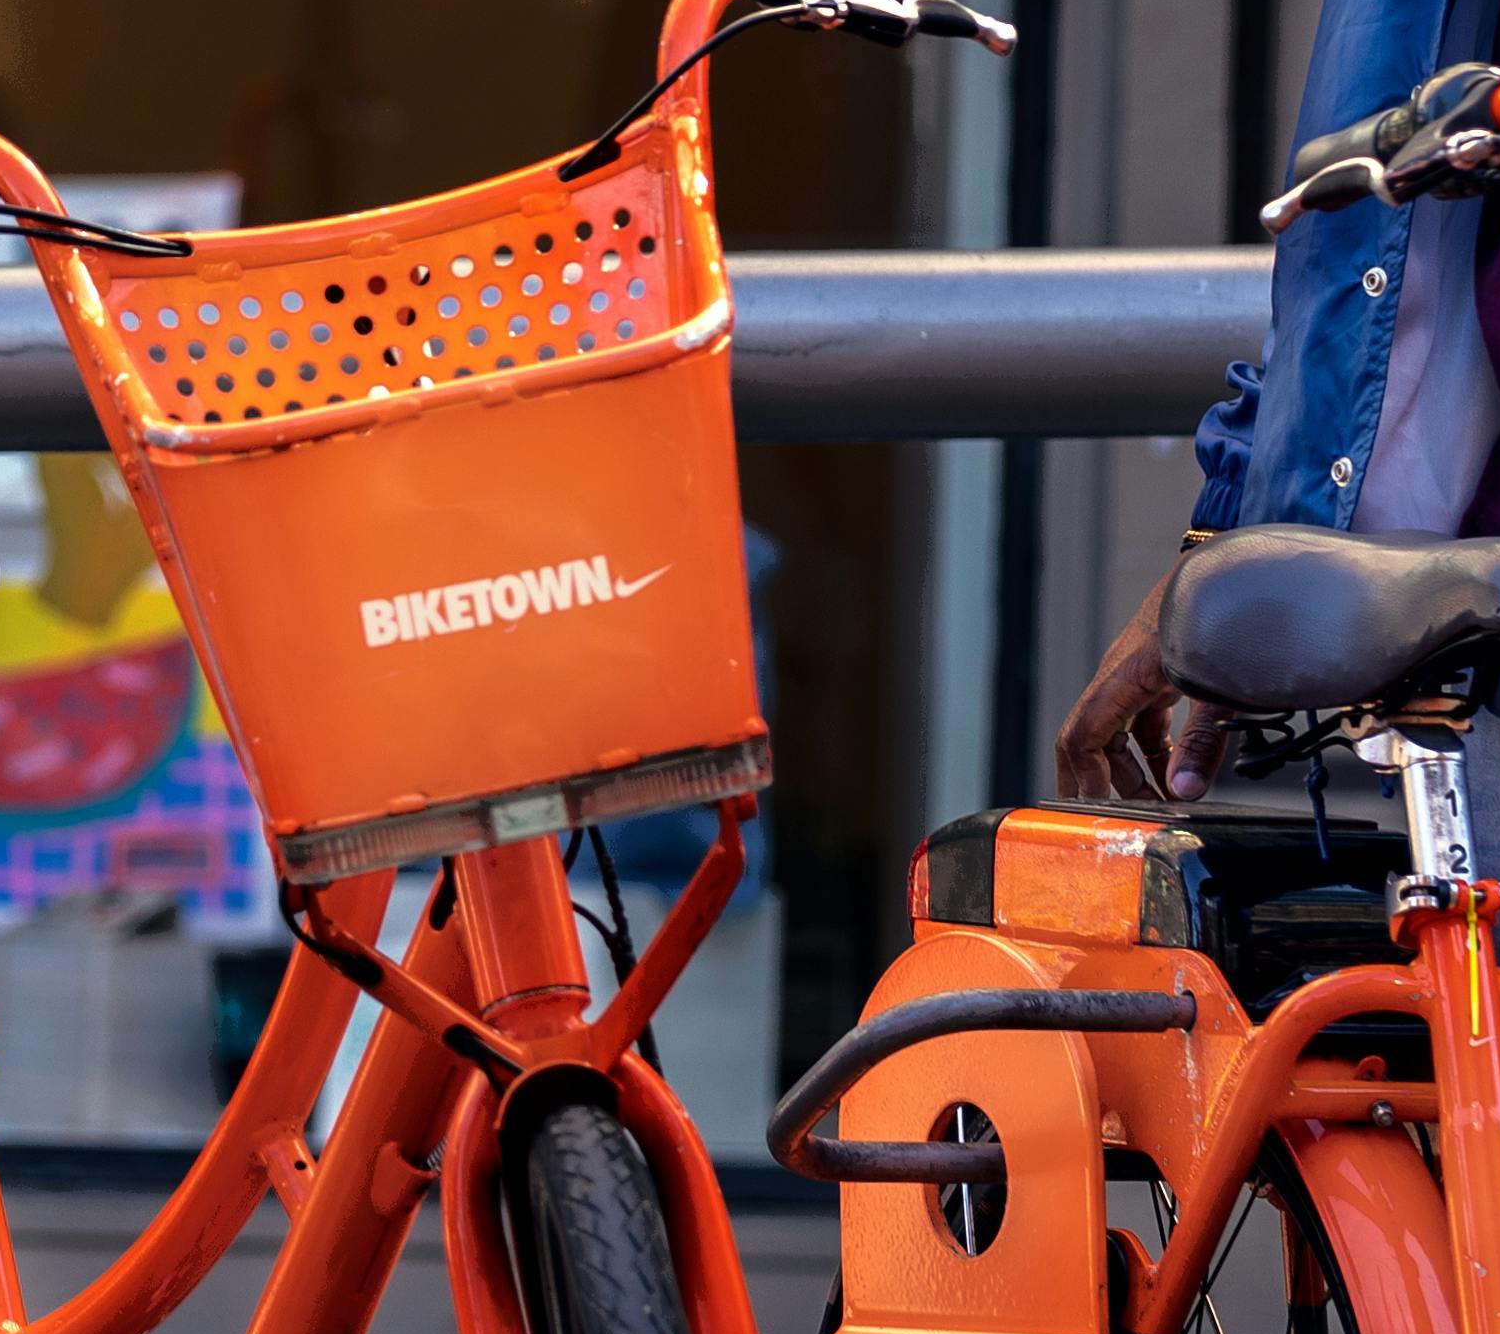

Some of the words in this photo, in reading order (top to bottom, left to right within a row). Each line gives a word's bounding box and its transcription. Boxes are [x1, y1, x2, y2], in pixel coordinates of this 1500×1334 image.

[360, 555, 614, 648] BIKETOWN
[1445, 788, 1458, 817] 1
[1448, 843, 1470, 874] 2
